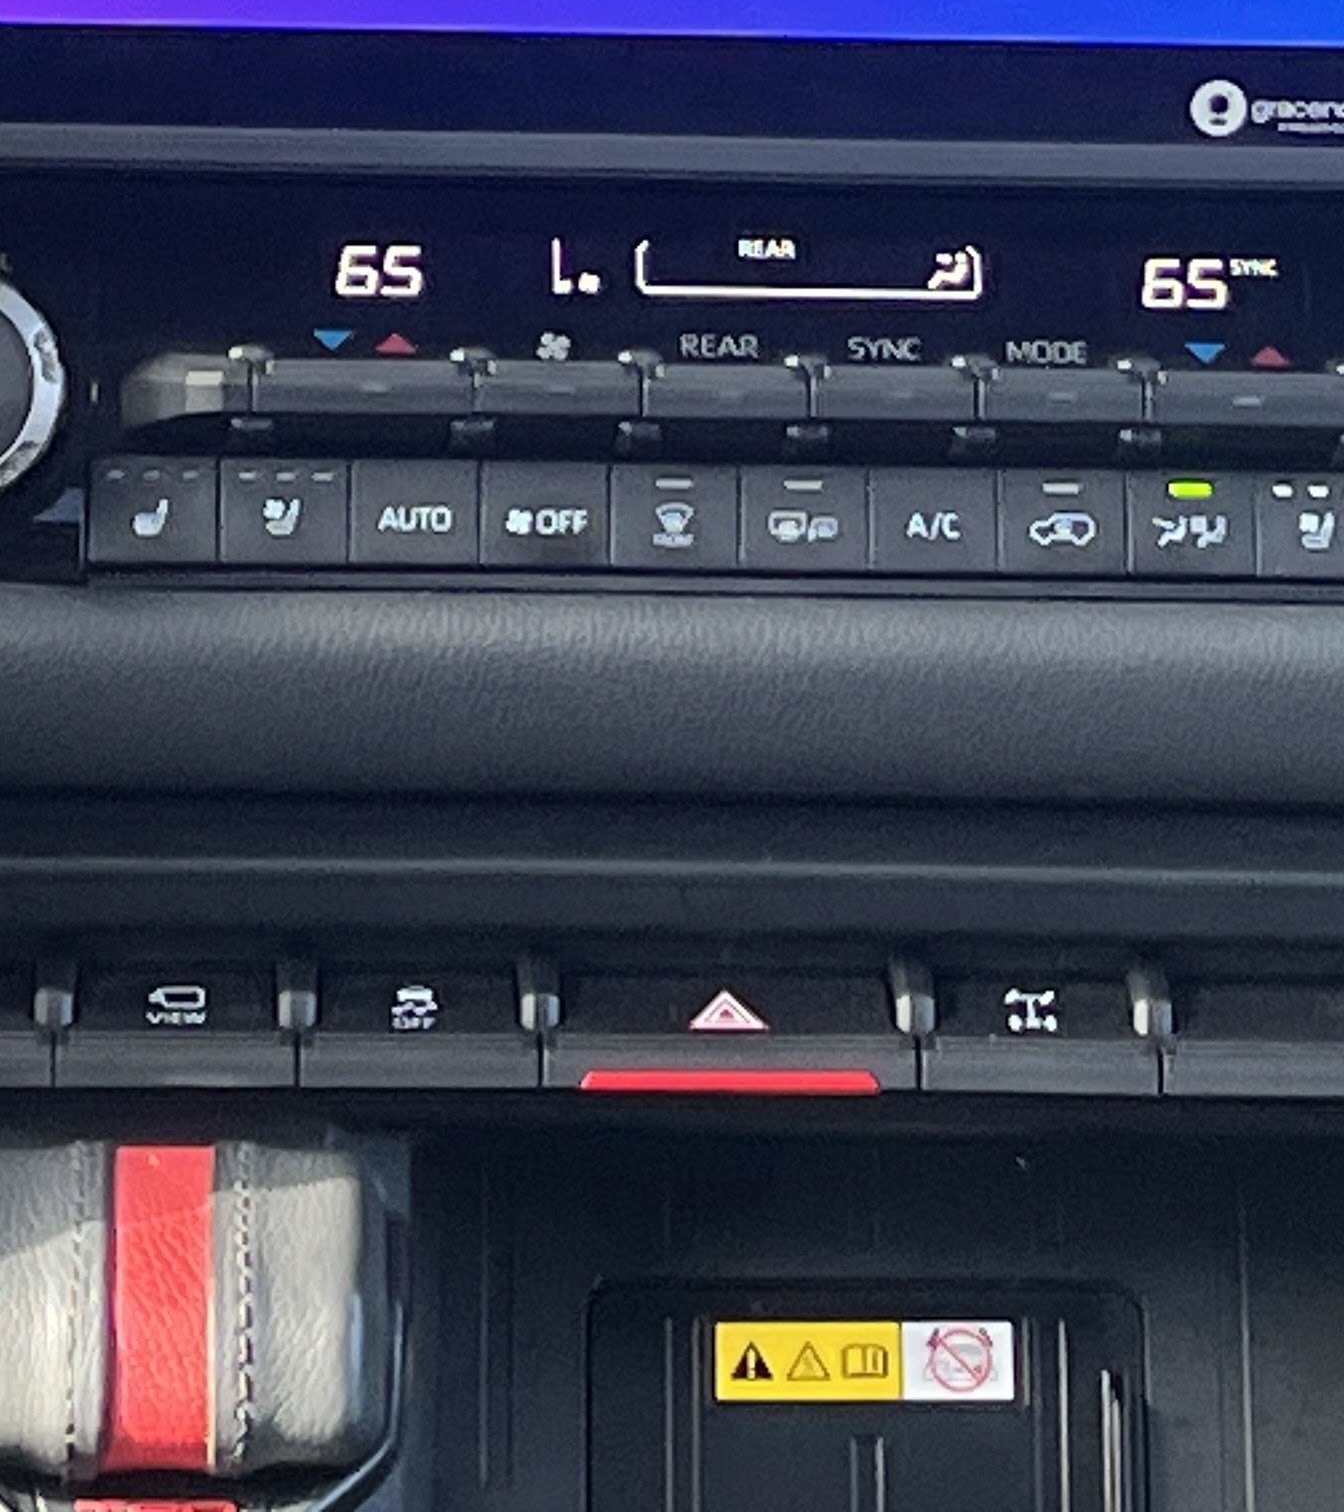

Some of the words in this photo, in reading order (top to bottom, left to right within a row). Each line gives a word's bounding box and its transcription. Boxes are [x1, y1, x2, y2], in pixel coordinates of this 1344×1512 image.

[737, 238, 796, 260] REAR
[333, 244, 424, 296] 65
[1140, 257, 1230, 310] 65
[680, 333, 758, 359] REAR
[847, 336, 921, 361] SYNC
[1005, 340, 1088, 364] MODE
[377, 506, 452, 532] AUTO
[536, 509, 589, 535] OFF
[906, 512, 961, 540] A/C
